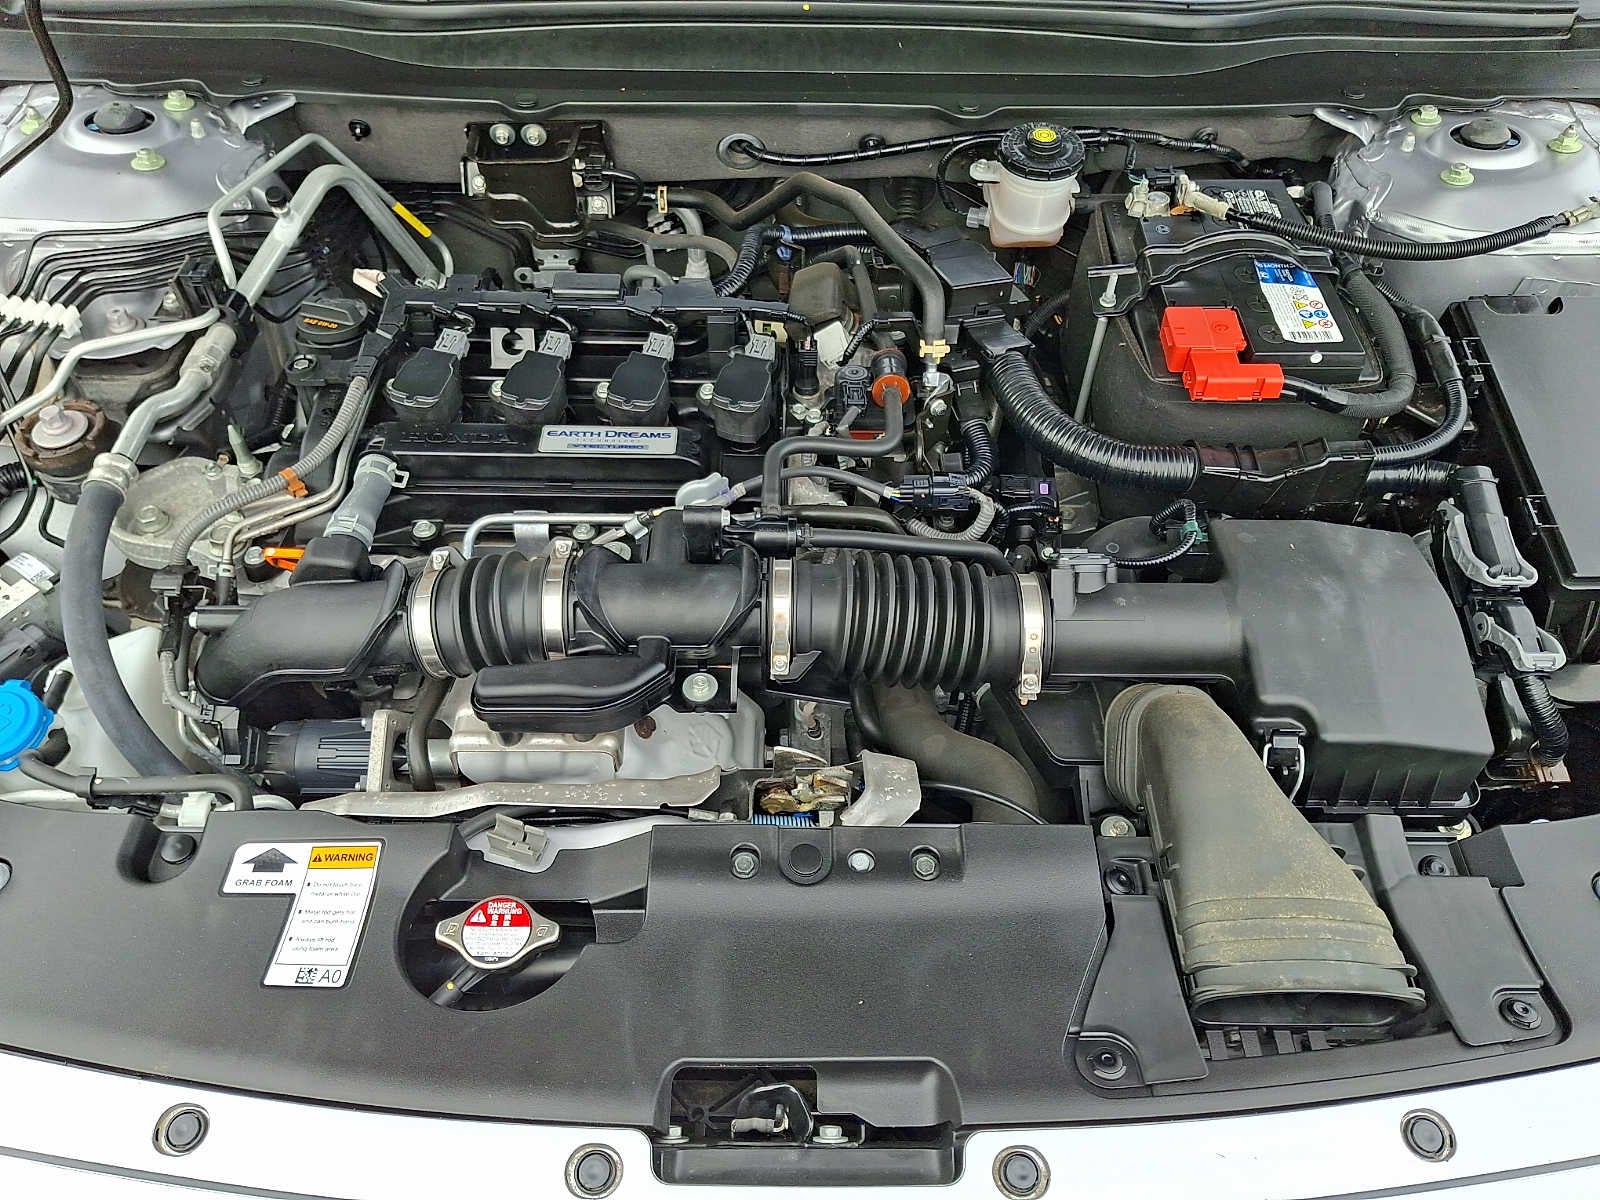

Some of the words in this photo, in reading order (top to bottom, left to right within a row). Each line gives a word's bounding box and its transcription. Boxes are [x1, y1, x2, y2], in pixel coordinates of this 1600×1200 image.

[400, 431, 518, 444] HONDA
[547, 430, 600, 438] EARTH
[605, 430, 671, 439] DREAMS
[324, 853, 374, 862] WARNING
[235, 879, 262, 887] GRAB
[265, 879, 293, 887] FOAM
